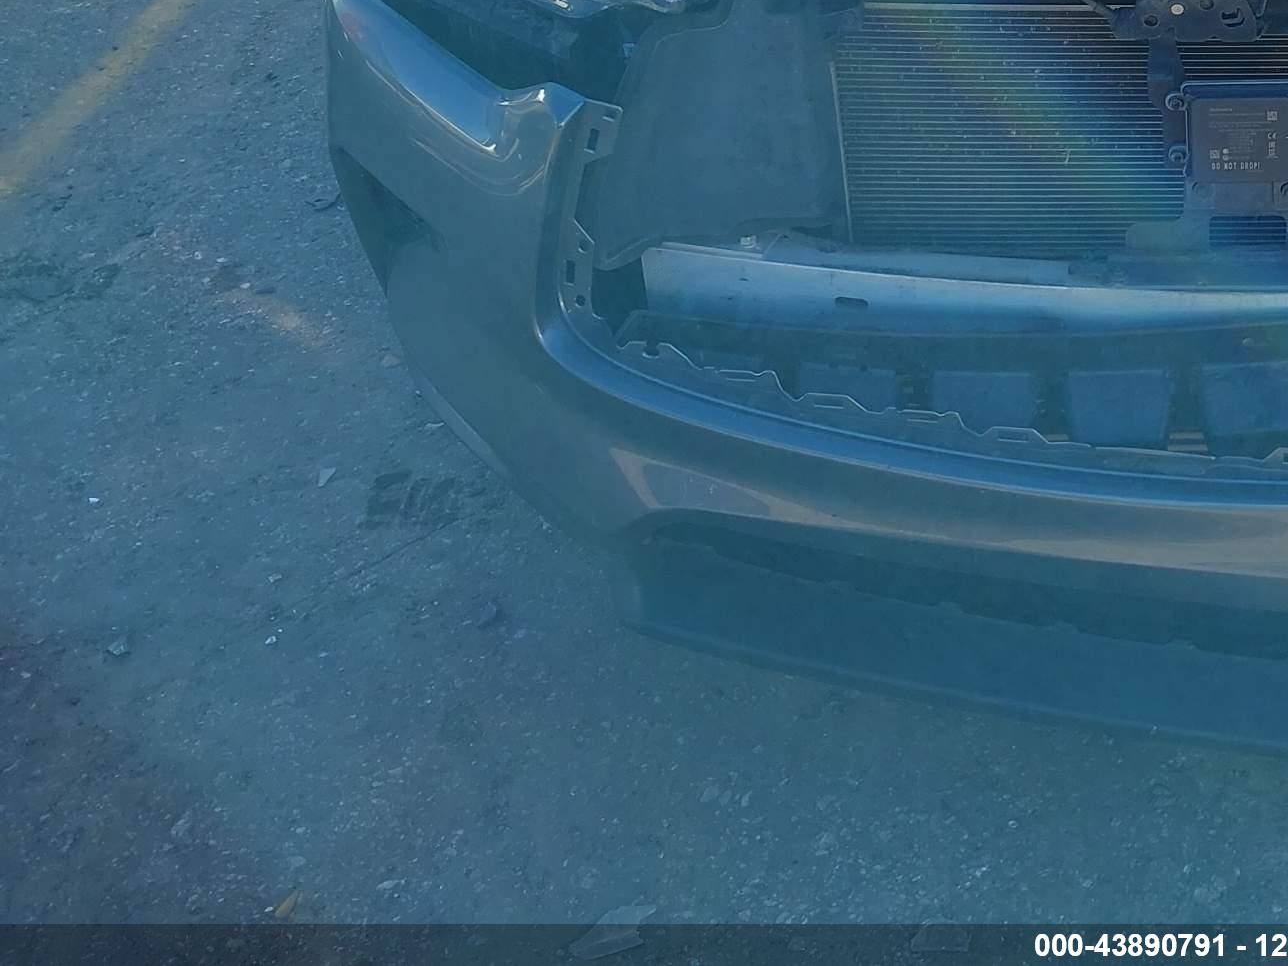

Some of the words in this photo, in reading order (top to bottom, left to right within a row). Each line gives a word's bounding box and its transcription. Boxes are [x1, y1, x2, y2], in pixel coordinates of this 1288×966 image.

[1211, 161, 1221, 170] DO
[1223, 161, 1237, 170] NOT
[1240, 161, 1260, 170] DROP!
